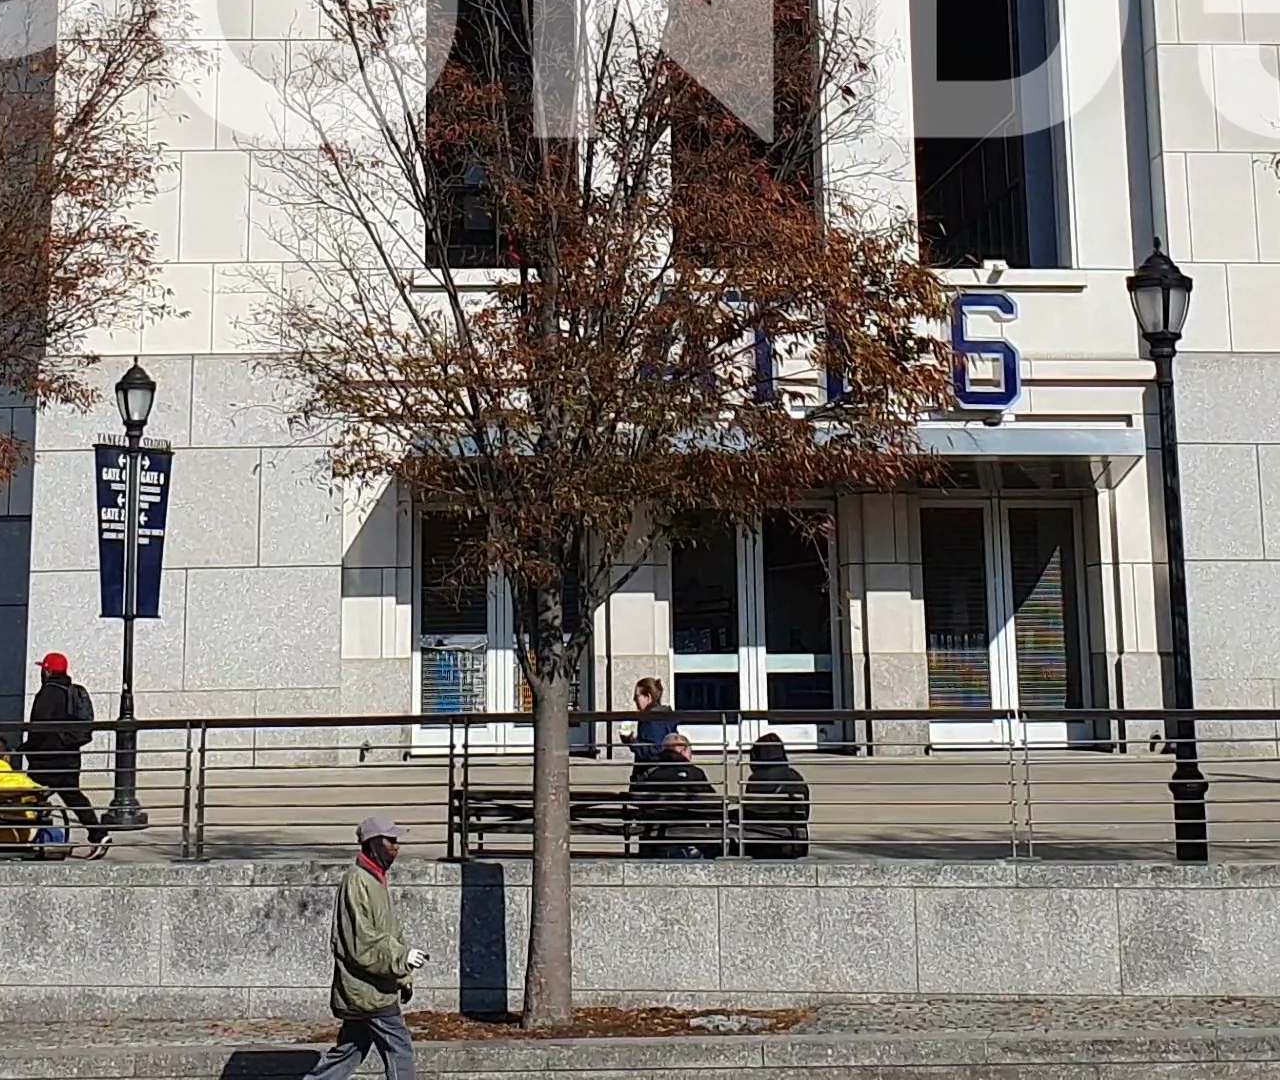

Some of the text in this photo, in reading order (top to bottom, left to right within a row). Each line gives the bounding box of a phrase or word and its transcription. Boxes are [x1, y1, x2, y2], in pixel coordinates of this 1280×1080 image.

[950, 289, 1022, 411] 6
[102, 467, 121, 481] GATE
[140, 471, 158, 485] GATE
[101, 507, 120, 521] GATE
